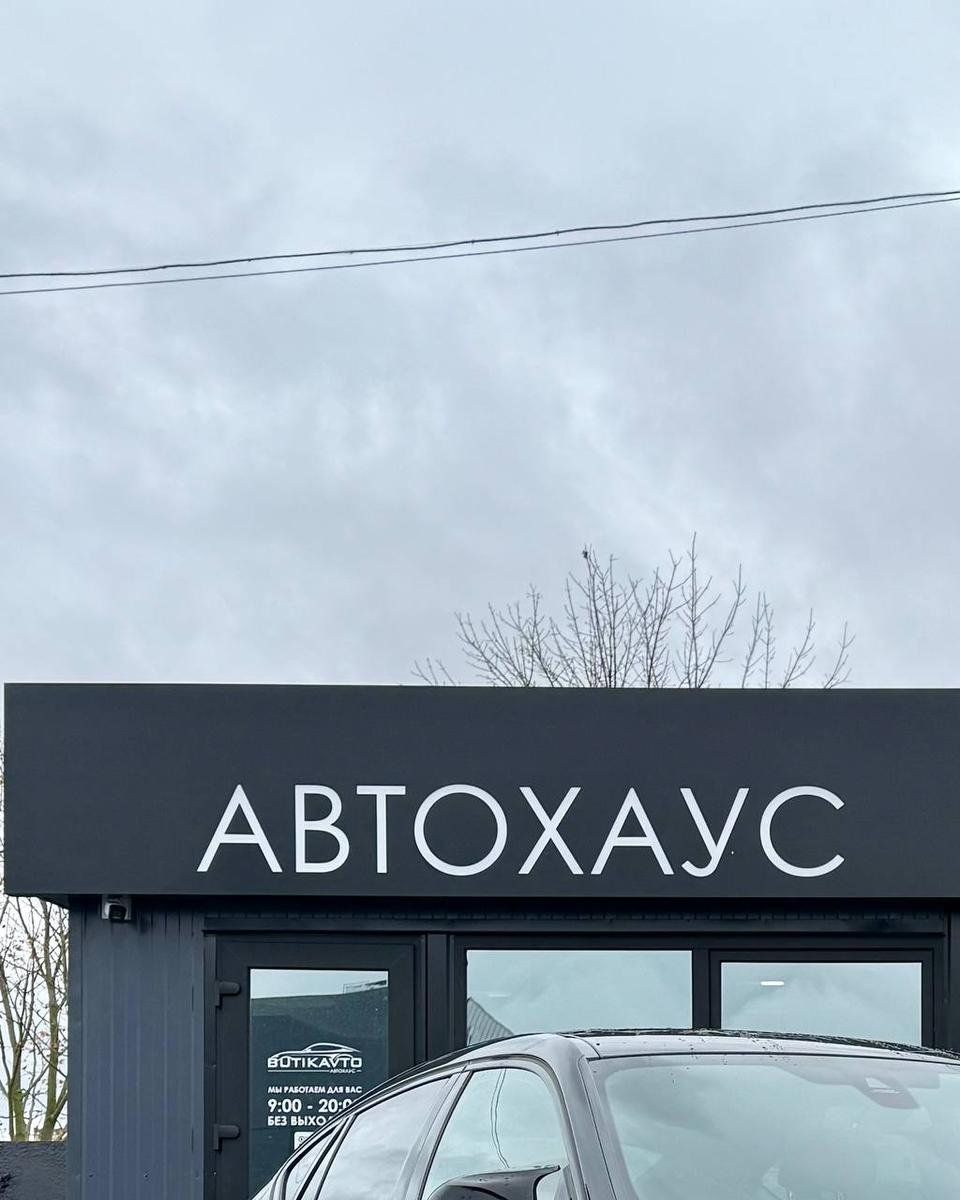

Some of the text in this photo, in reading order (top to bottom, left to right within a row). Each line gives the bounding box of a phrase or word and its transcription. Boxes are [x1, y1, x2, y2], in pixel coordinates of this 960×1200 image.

[197, 783, 846, 879] АВТОХАУС
[267, 1057, 363, 1069] BUTIKAVTO
[267, 1086, 363, 1095] МЫ РАБОТАЕМ ДЛЯ ВАС
[267, 1099, 303, 1113] 9:00
[318, 1099, 353, 1113] 20:0
[267, 1115, 333, 1126] БЕЗ ВЫХО
